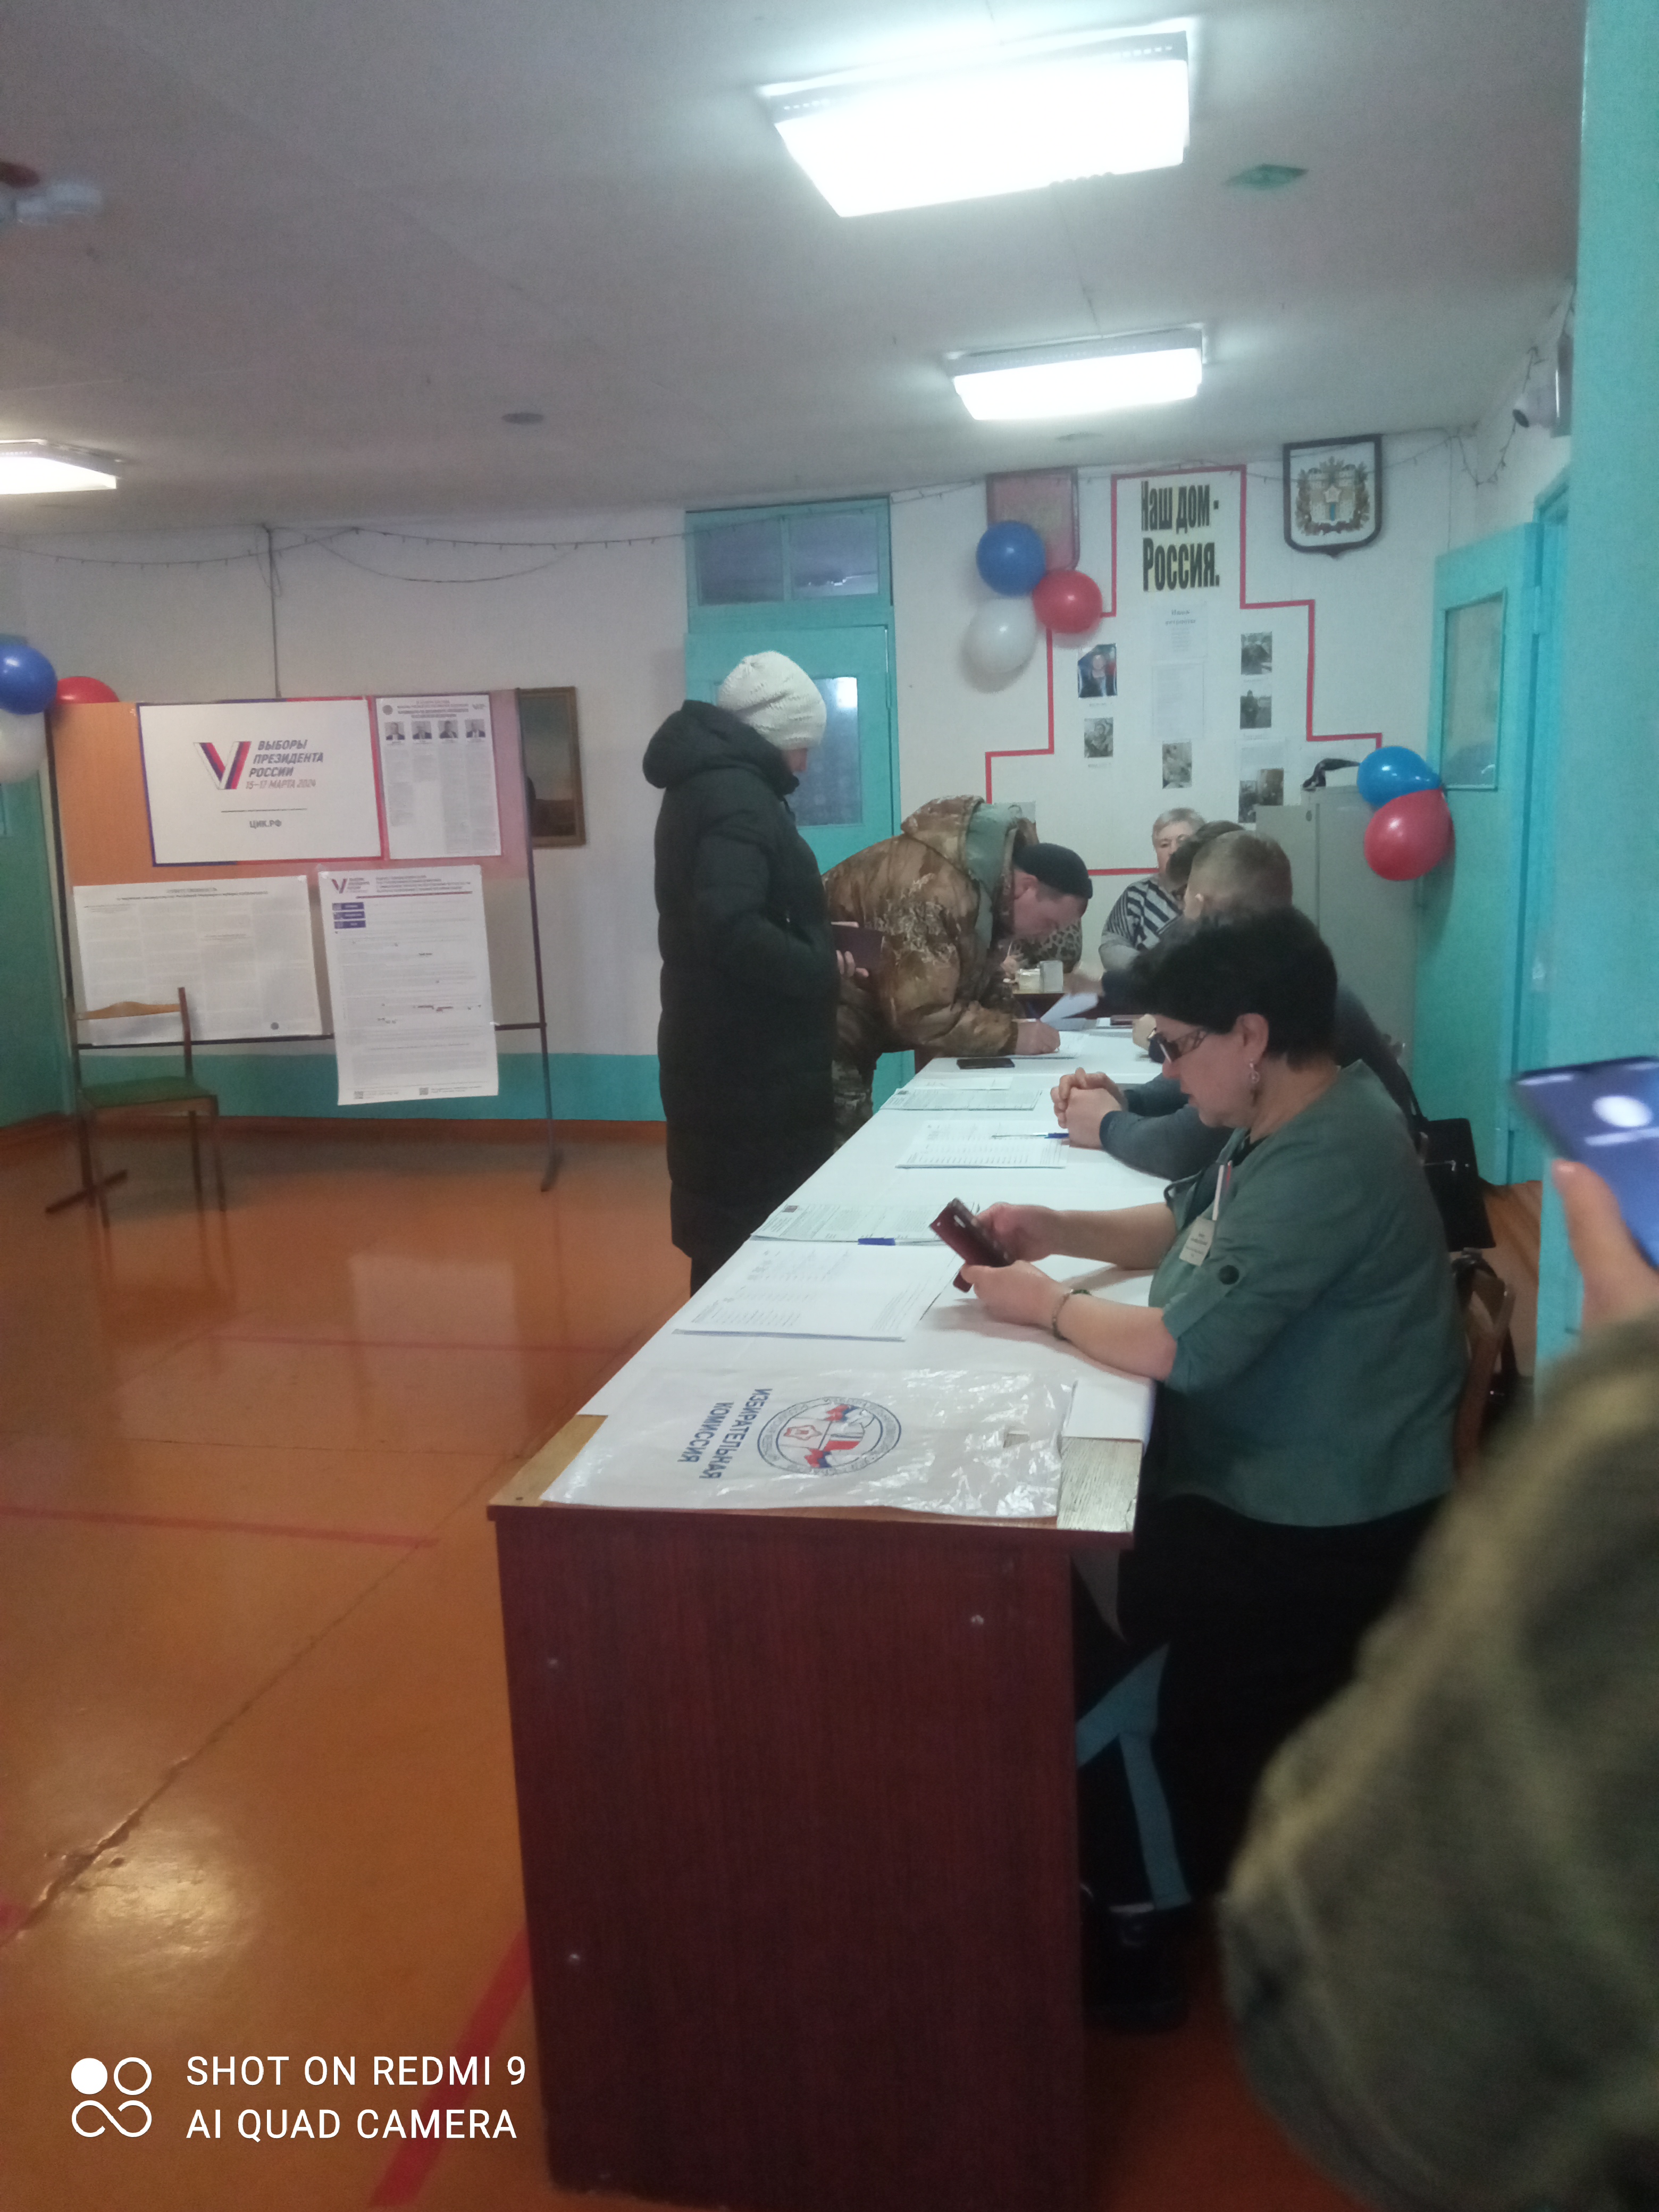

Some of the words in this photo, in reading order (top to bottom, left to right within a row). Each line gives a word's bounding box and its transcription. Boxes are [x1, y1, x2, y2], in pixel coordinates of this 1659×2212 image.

[1141, 481, 1172, 531] Наш
[1176, 484, 1210, 534] дом
[1143, 537, 1220, 592] Россия.
[258, 740, 307, 750] ВЫБОРЫ
[254, 753, 323, 764] ПРЕЗИДЕНТА
[249, 767, 294, 777] РОССИИ
[268, 780, 295, 789] МАРТА
[249, 819, 282, 829] ЦИК.РФ
[677, 1402, 734, 1462] КОМИССИЯ
[699, 1388, 773, 1479] ИЗБИРАТЕЛЬНАЯ
